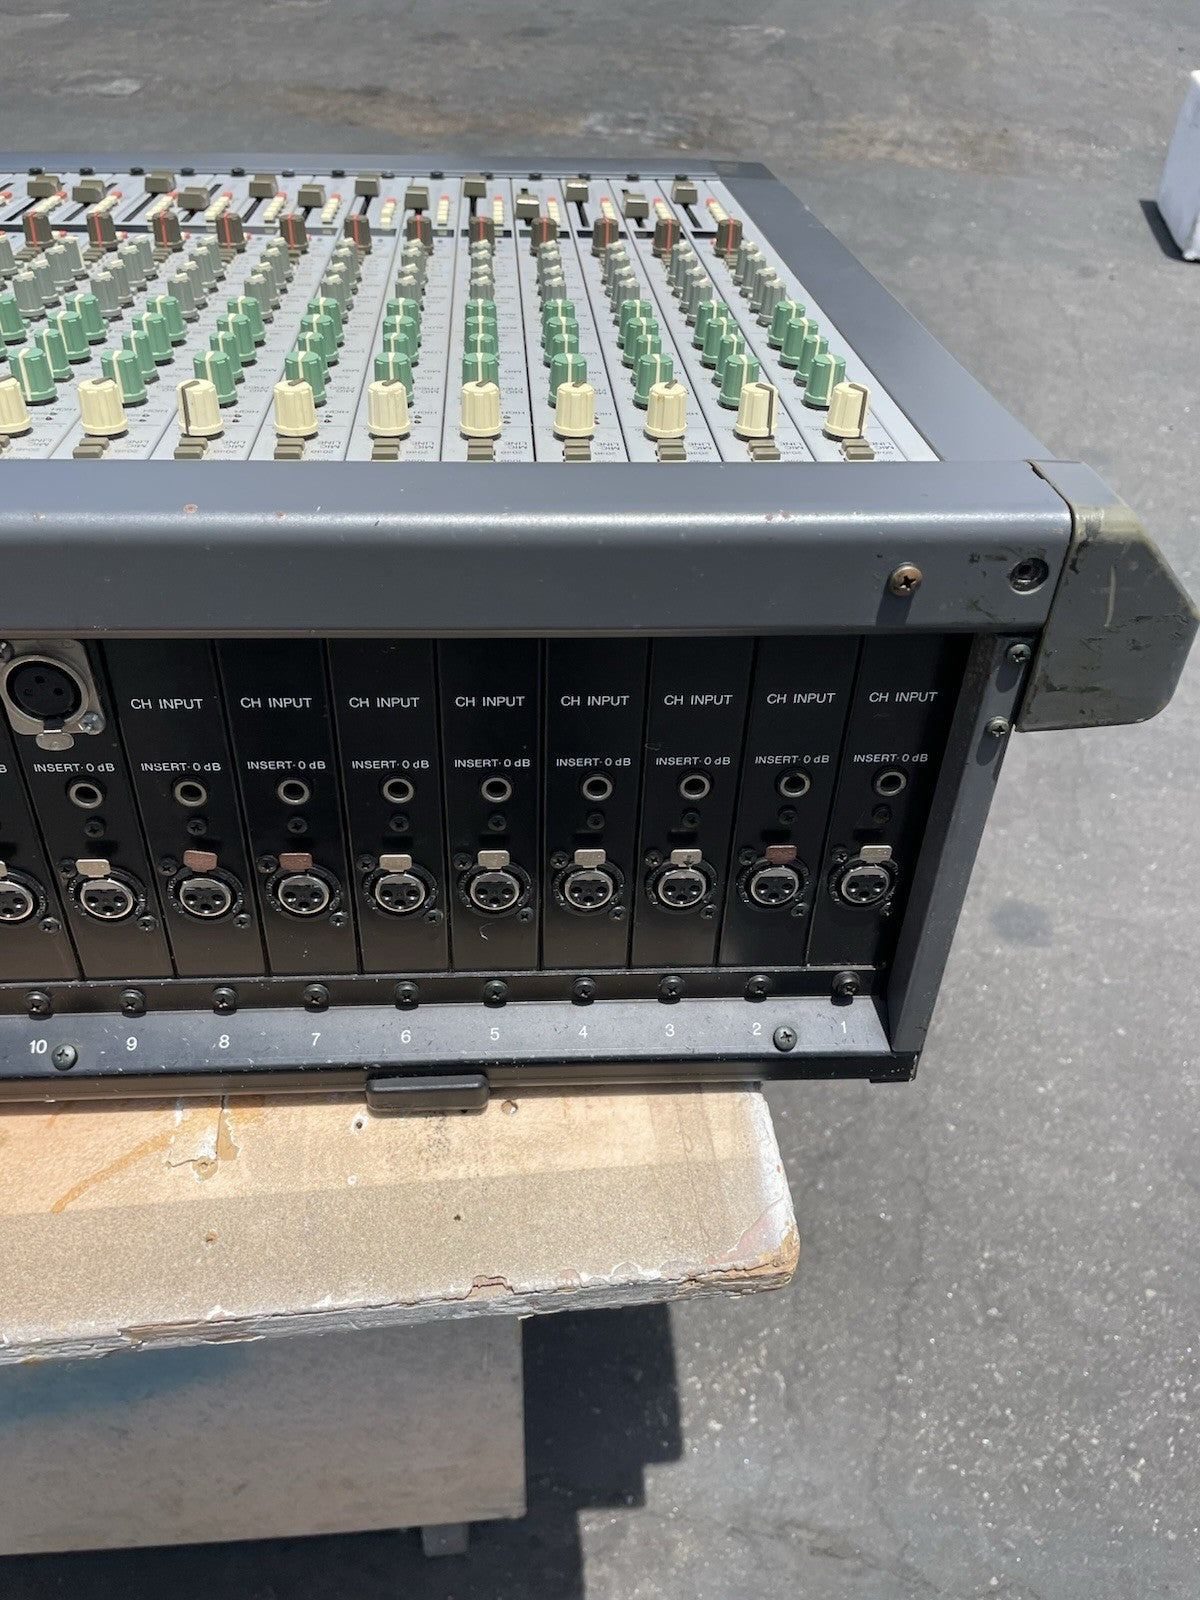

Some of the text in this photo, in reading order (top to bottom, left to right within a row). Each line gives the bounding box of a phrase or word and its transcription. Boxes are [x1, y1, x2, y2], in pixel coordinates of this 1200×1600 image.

[130, 698, 203, 710] CH INPUT
[240, 696, 313, 709] CH INPUT
[348, 696, 420, 709] CH INPUT
[455, 695, 525, 708] CH INPUT
[560, 695, 630, 707] CH INPUT
[663, 694, 733, 706] CH INPUT
[766, 692, 836, 705] CH INPUT
[869, 691, 938, 703] CH INPUT
[489, 1027, 501, 1042] 5
[577, 1025, 589, 1040] 4
[664, 1023, 676, 1038] 3
[751, 1022, 763, 1036] 2
[840, 1020, 848, 1035] 1
[125, 1036, 138, 1052] 9
[218, 1033, 231, 1049] 8
[310, 1032, 322, 1047] 7
[400, 1029, 412, 1045] 6
[29, 1039, 48, 1055] 10
